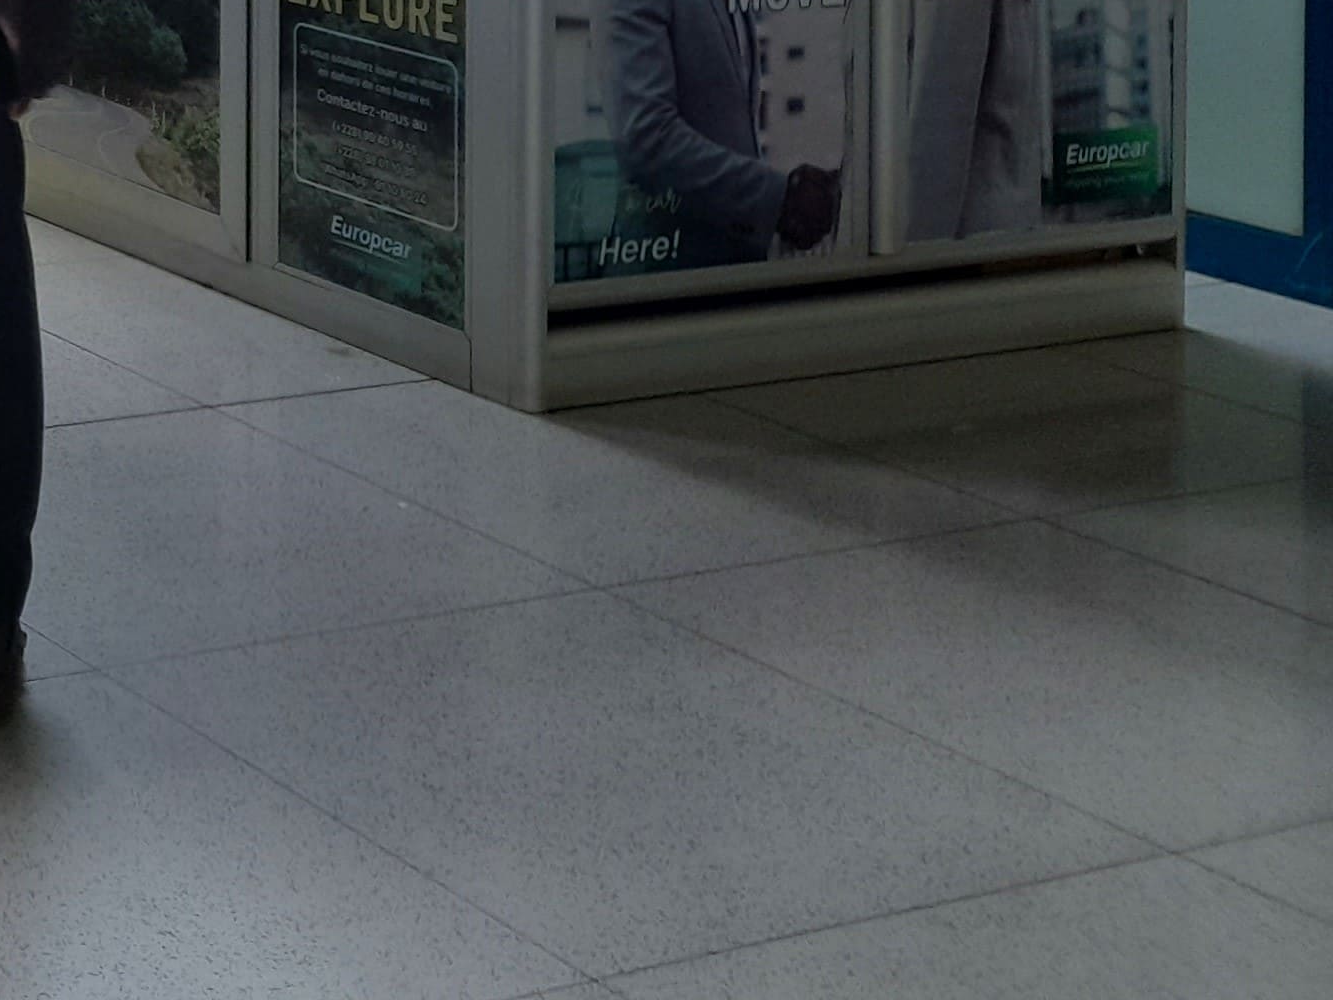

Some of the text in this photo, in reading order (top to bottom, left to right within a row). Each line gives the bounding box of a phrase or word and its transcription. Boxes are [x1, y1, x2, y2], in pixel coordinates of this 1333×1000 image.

[316, 87, 409, 128] Contactez-nous
[1065, 141, 1150, 169] Europcar
[330, 214, 412, 260] Europcar
[598, 227, 681, 267] Here!
